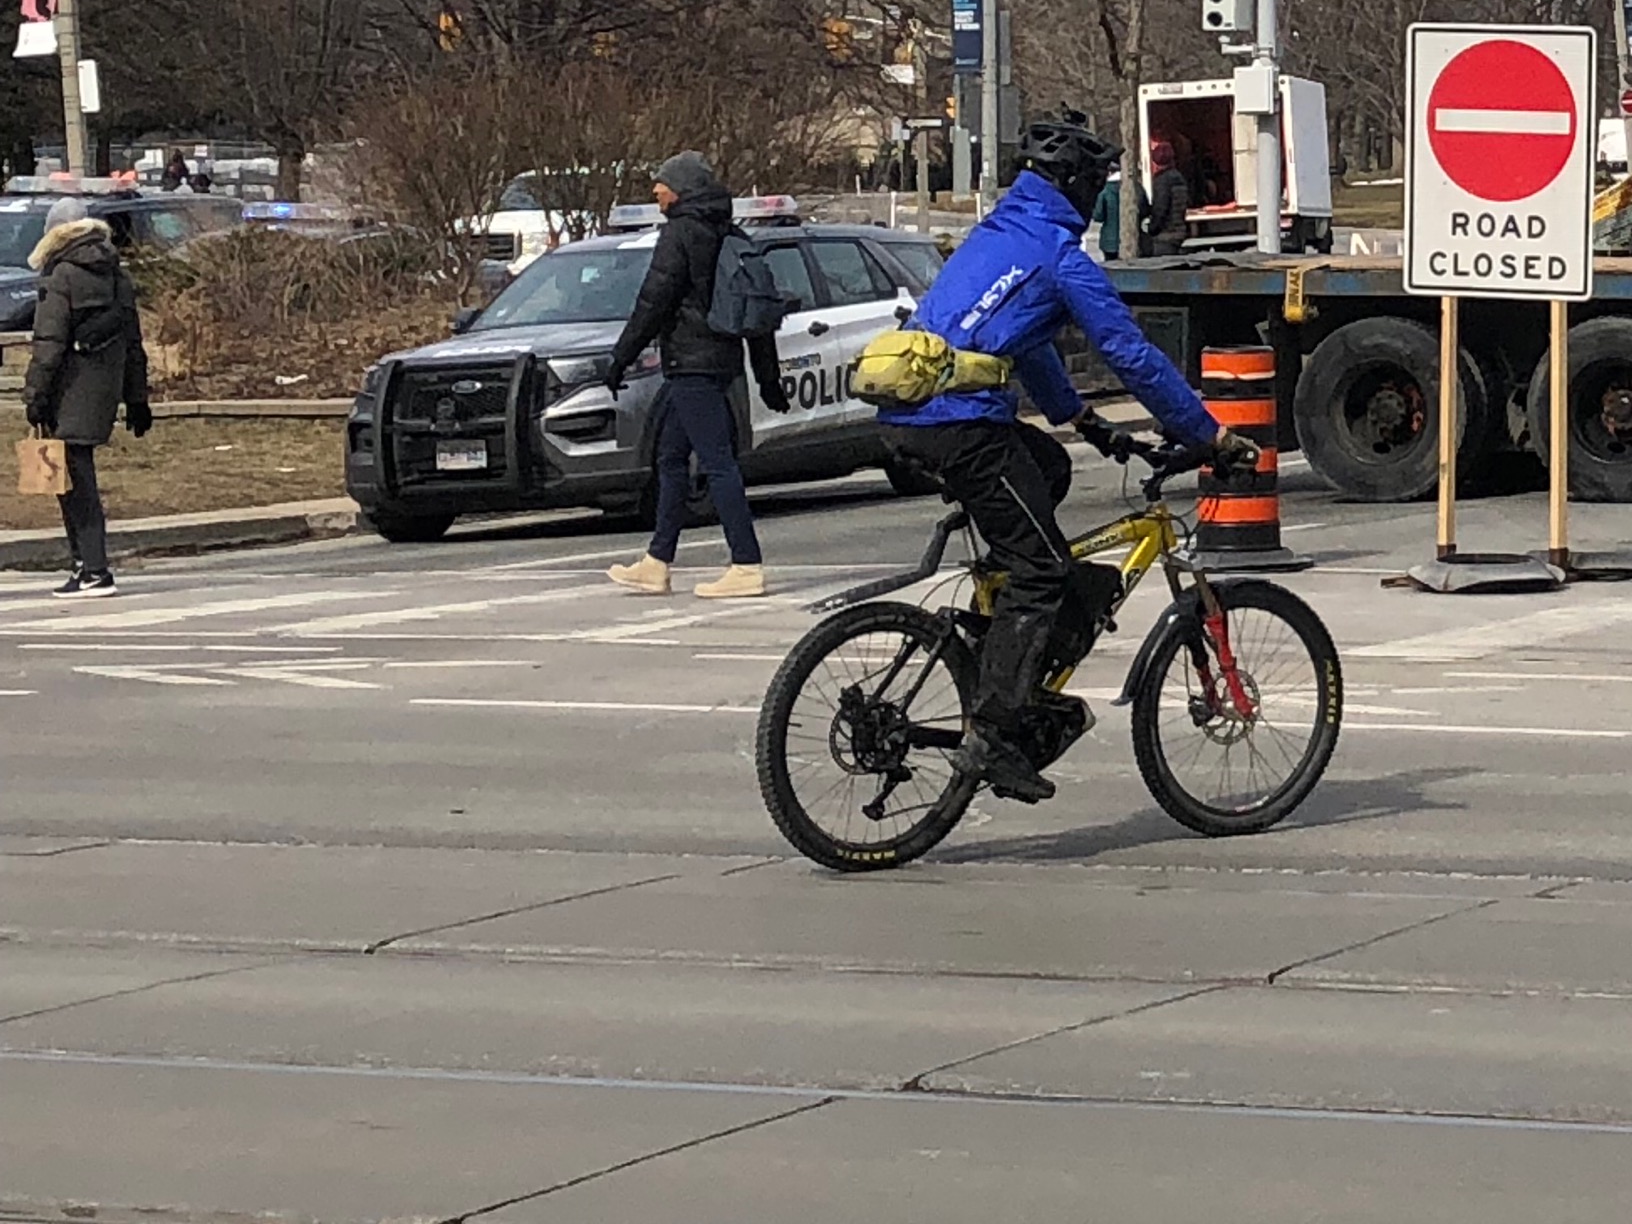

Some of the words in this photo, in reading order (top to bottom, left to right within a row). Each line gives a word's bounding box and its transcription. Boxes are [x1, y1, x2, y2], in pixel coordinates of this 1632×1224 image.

[1451, 212, 1546, 240] ROAD
[1429, 251, 1567, 281] CLOSED
[781, 364, 858, 410] POLIC
